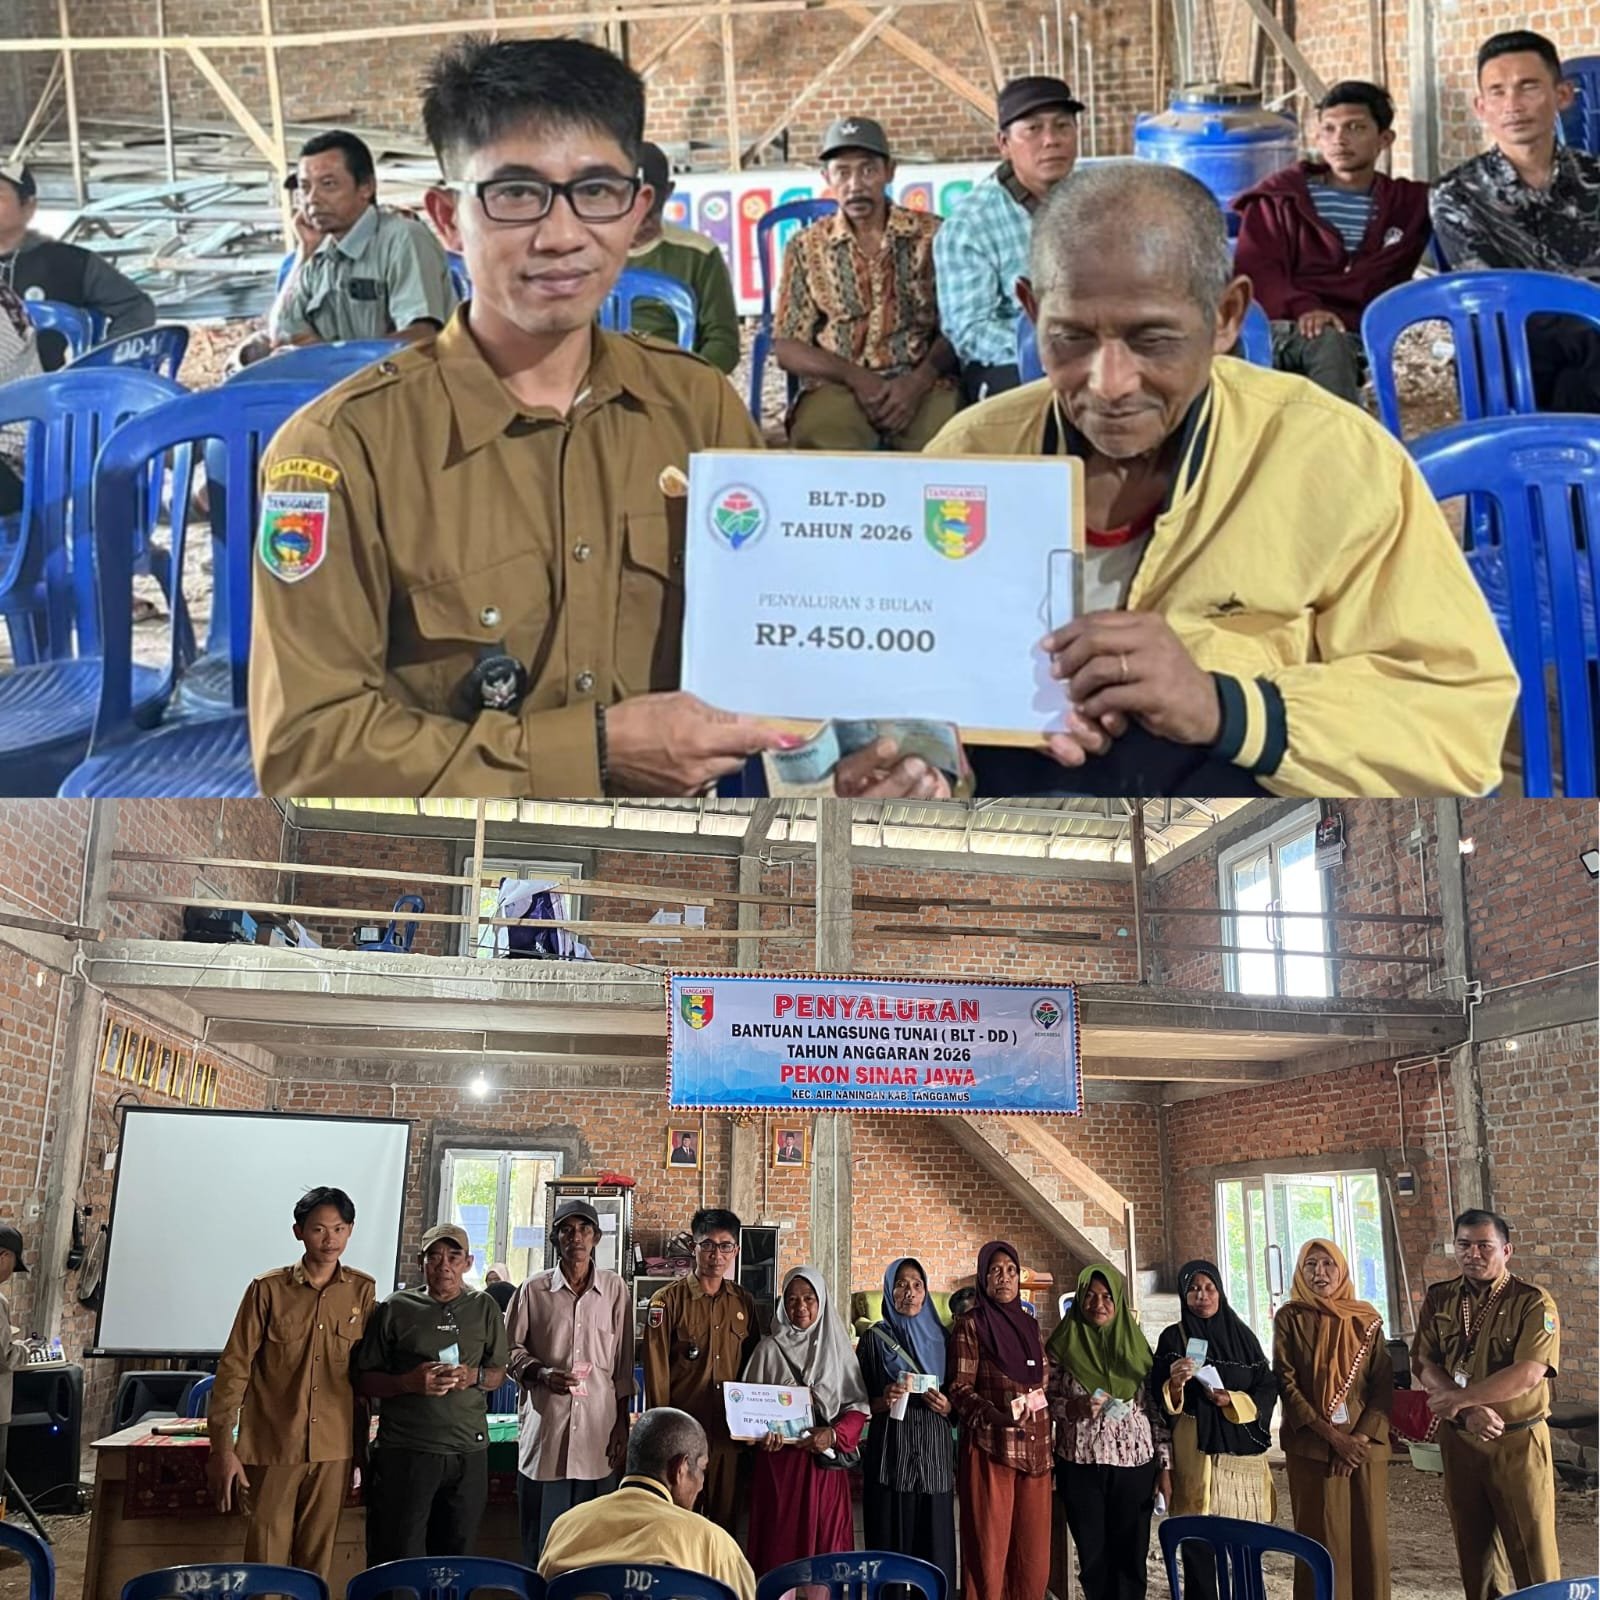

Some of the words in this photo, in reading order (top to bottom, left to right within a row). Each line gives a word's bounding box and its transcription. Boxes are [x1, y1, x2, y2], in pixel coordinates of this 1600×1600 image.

[808, 490, 887, 509] BLT-DD
[780, 521, 853, 539] TAHUN
[860, 523, 913, 541] 2026
[758, 593, 861, 611] PENYALURAN
[865, 597, 875, 611] 3
[879, 598, 933, 613] BULAN
[755, 623, 936, 653] RP.450.000
[773, 994, 980, 1023] PENYALURAN
[731, 1023, 803, 1038] BANTUAN
[807, 1025, 890, 1040] LANGSUNG
[894, 1027, 938, 1041] TUNAI
[787, 1044, 838, 1059] TAHUN
[842, 1045, 929, 1061] ANGGARAN
[933, 1048, 971, 1062] 2026
[780, 1064, 850, 1084] PEKON
[855, 1066, 918, 1086] SINAR
[923, 1067, 977, 1087] JAWA
[792, 1089, 814, 1099] KEC.
[816, 1090, 832, 1099] AIR
[835, 1090, 885, 1101] NANINGAN
[888, 1091, 910, 1102] KAB.
[912, 1092, 970, 1102] TANGGAMUS
